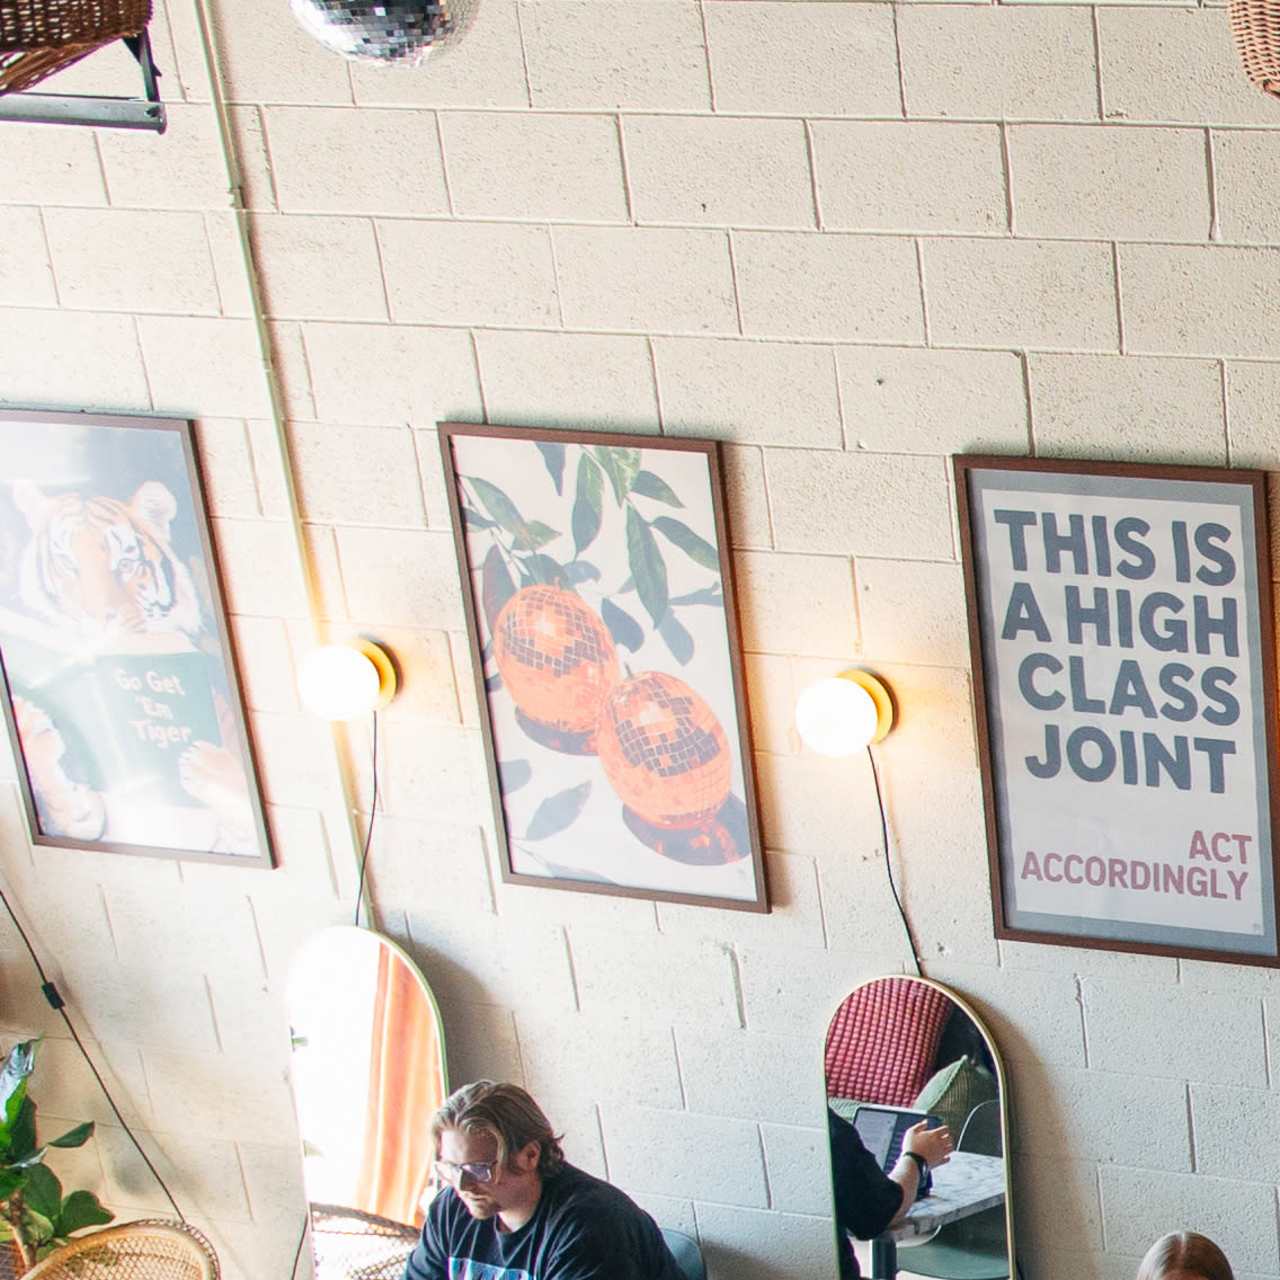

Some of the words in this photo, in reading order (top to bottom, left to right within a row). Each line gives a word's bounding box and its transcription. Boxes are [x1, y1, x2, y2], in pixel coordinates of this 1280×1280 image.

[995, 509, 1156, 580] THIS
[1172, 520, 1237, 586] IS
[1001, 581, 1051, 642] A
[1066, 585, 1240, 658] HIGH
[113, 668, 142, 691] Go
[144, 671, 186, 696] Get
[1017, 653, 1241, 726] CLASS
[128, 719, 192, 749] Tiger
[1024, 724, 1237, 794] JOINT
[1020, 851, 1249, 901] ACCORDINGLY
[1189, 830, 1252, 864] ACT
